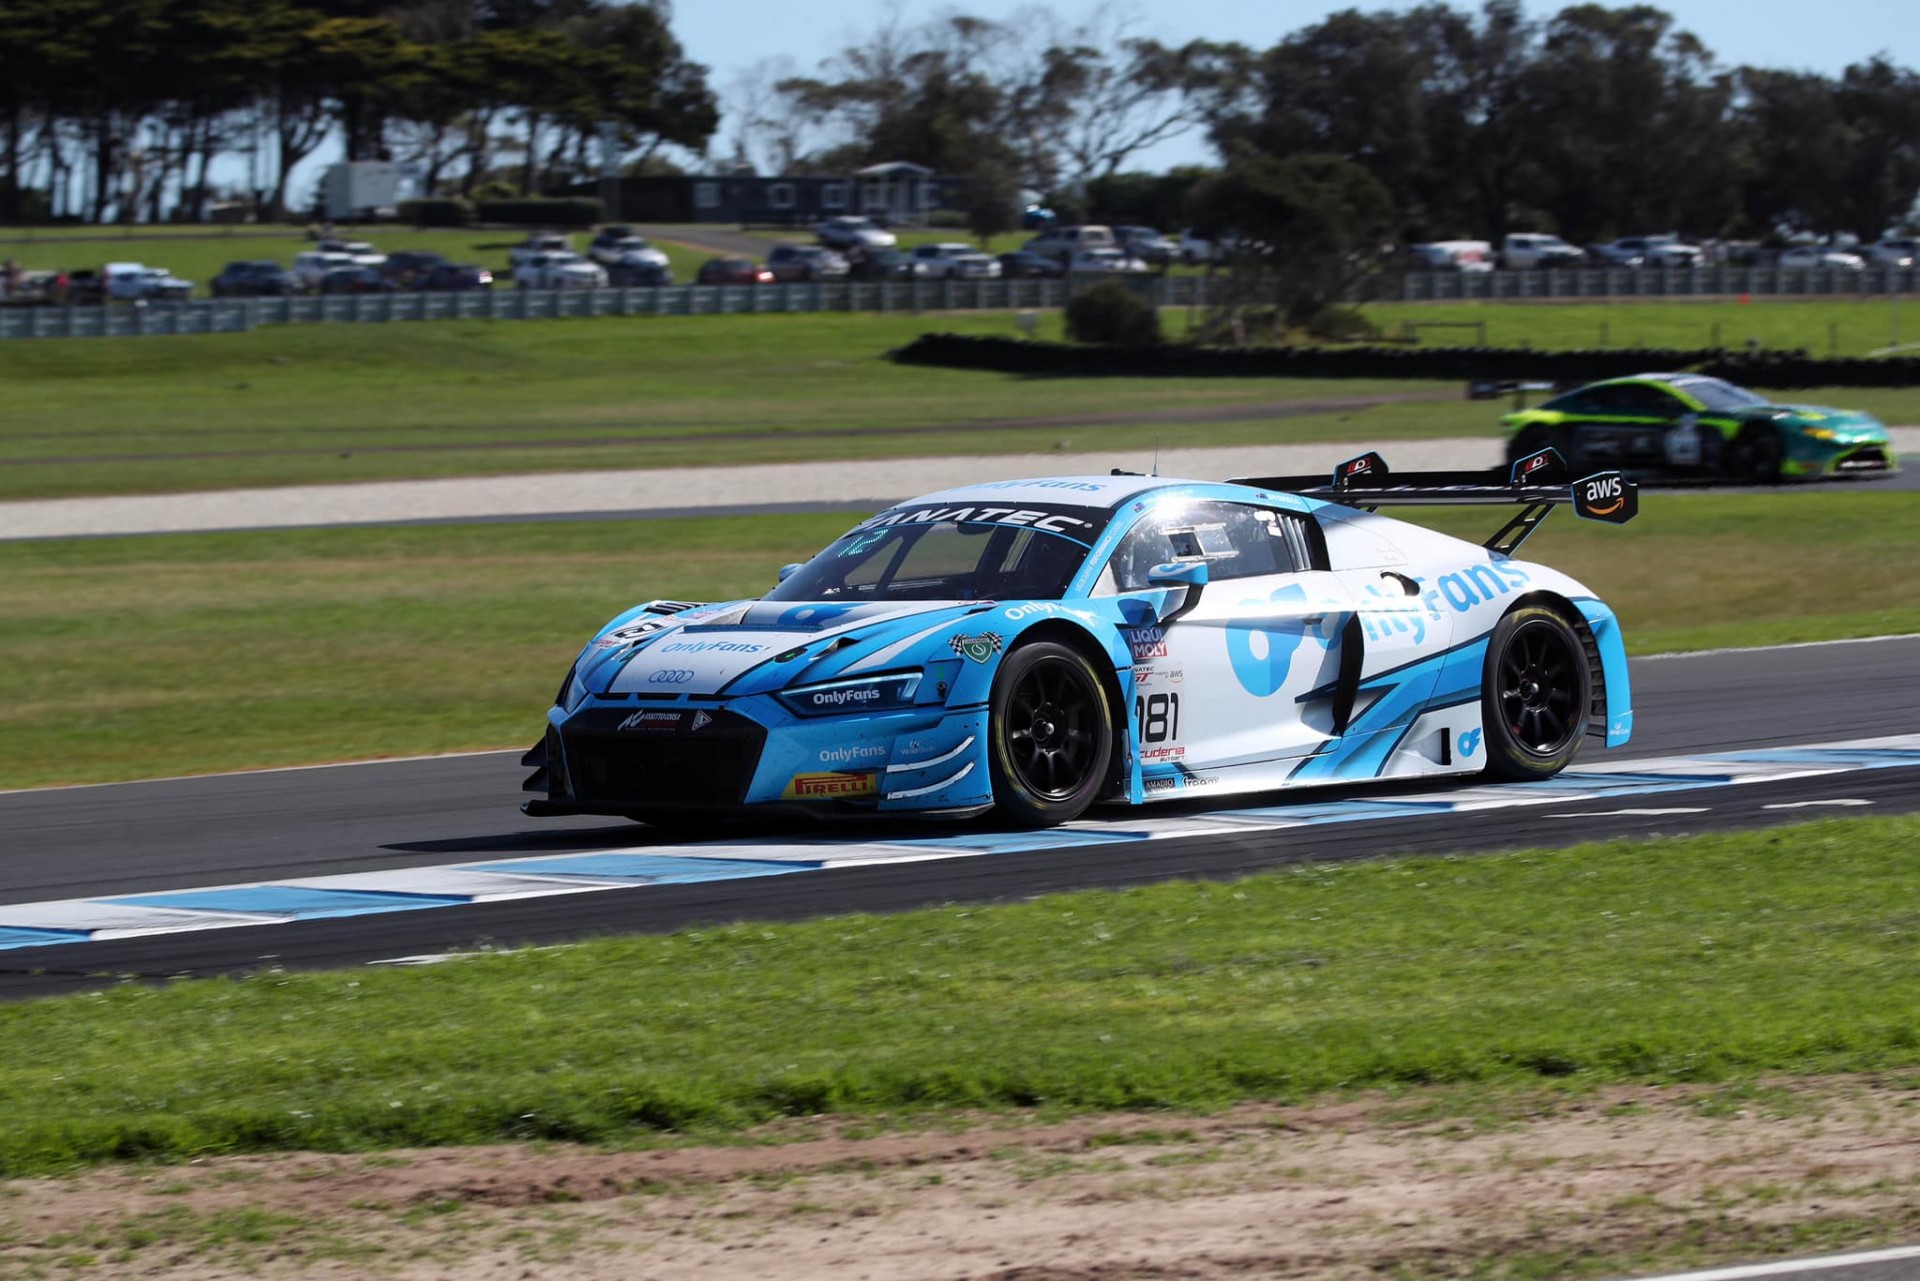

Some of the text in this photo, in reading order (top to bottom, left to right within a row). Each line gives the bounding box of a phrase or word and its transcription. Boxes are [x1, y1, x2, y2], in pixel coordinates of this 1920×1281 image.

[1586, 476, 1622, 501] aws
[862, 507, 1085, 532] FANATEC
[1130, 628, 1163, 643] LIQUI
[661, 641, 763, 654] OnlyFans
[1134, 641, 1166, 657] MOLY
[813, 688, 880, 705] OnlyFans
[1137, 692, 1178, 743] 181
[819, 745, 886, 762] OnlyFans
[1126, 746, 1184, 759] cuderia
[794, 774, 868, 796] PIRELLI
